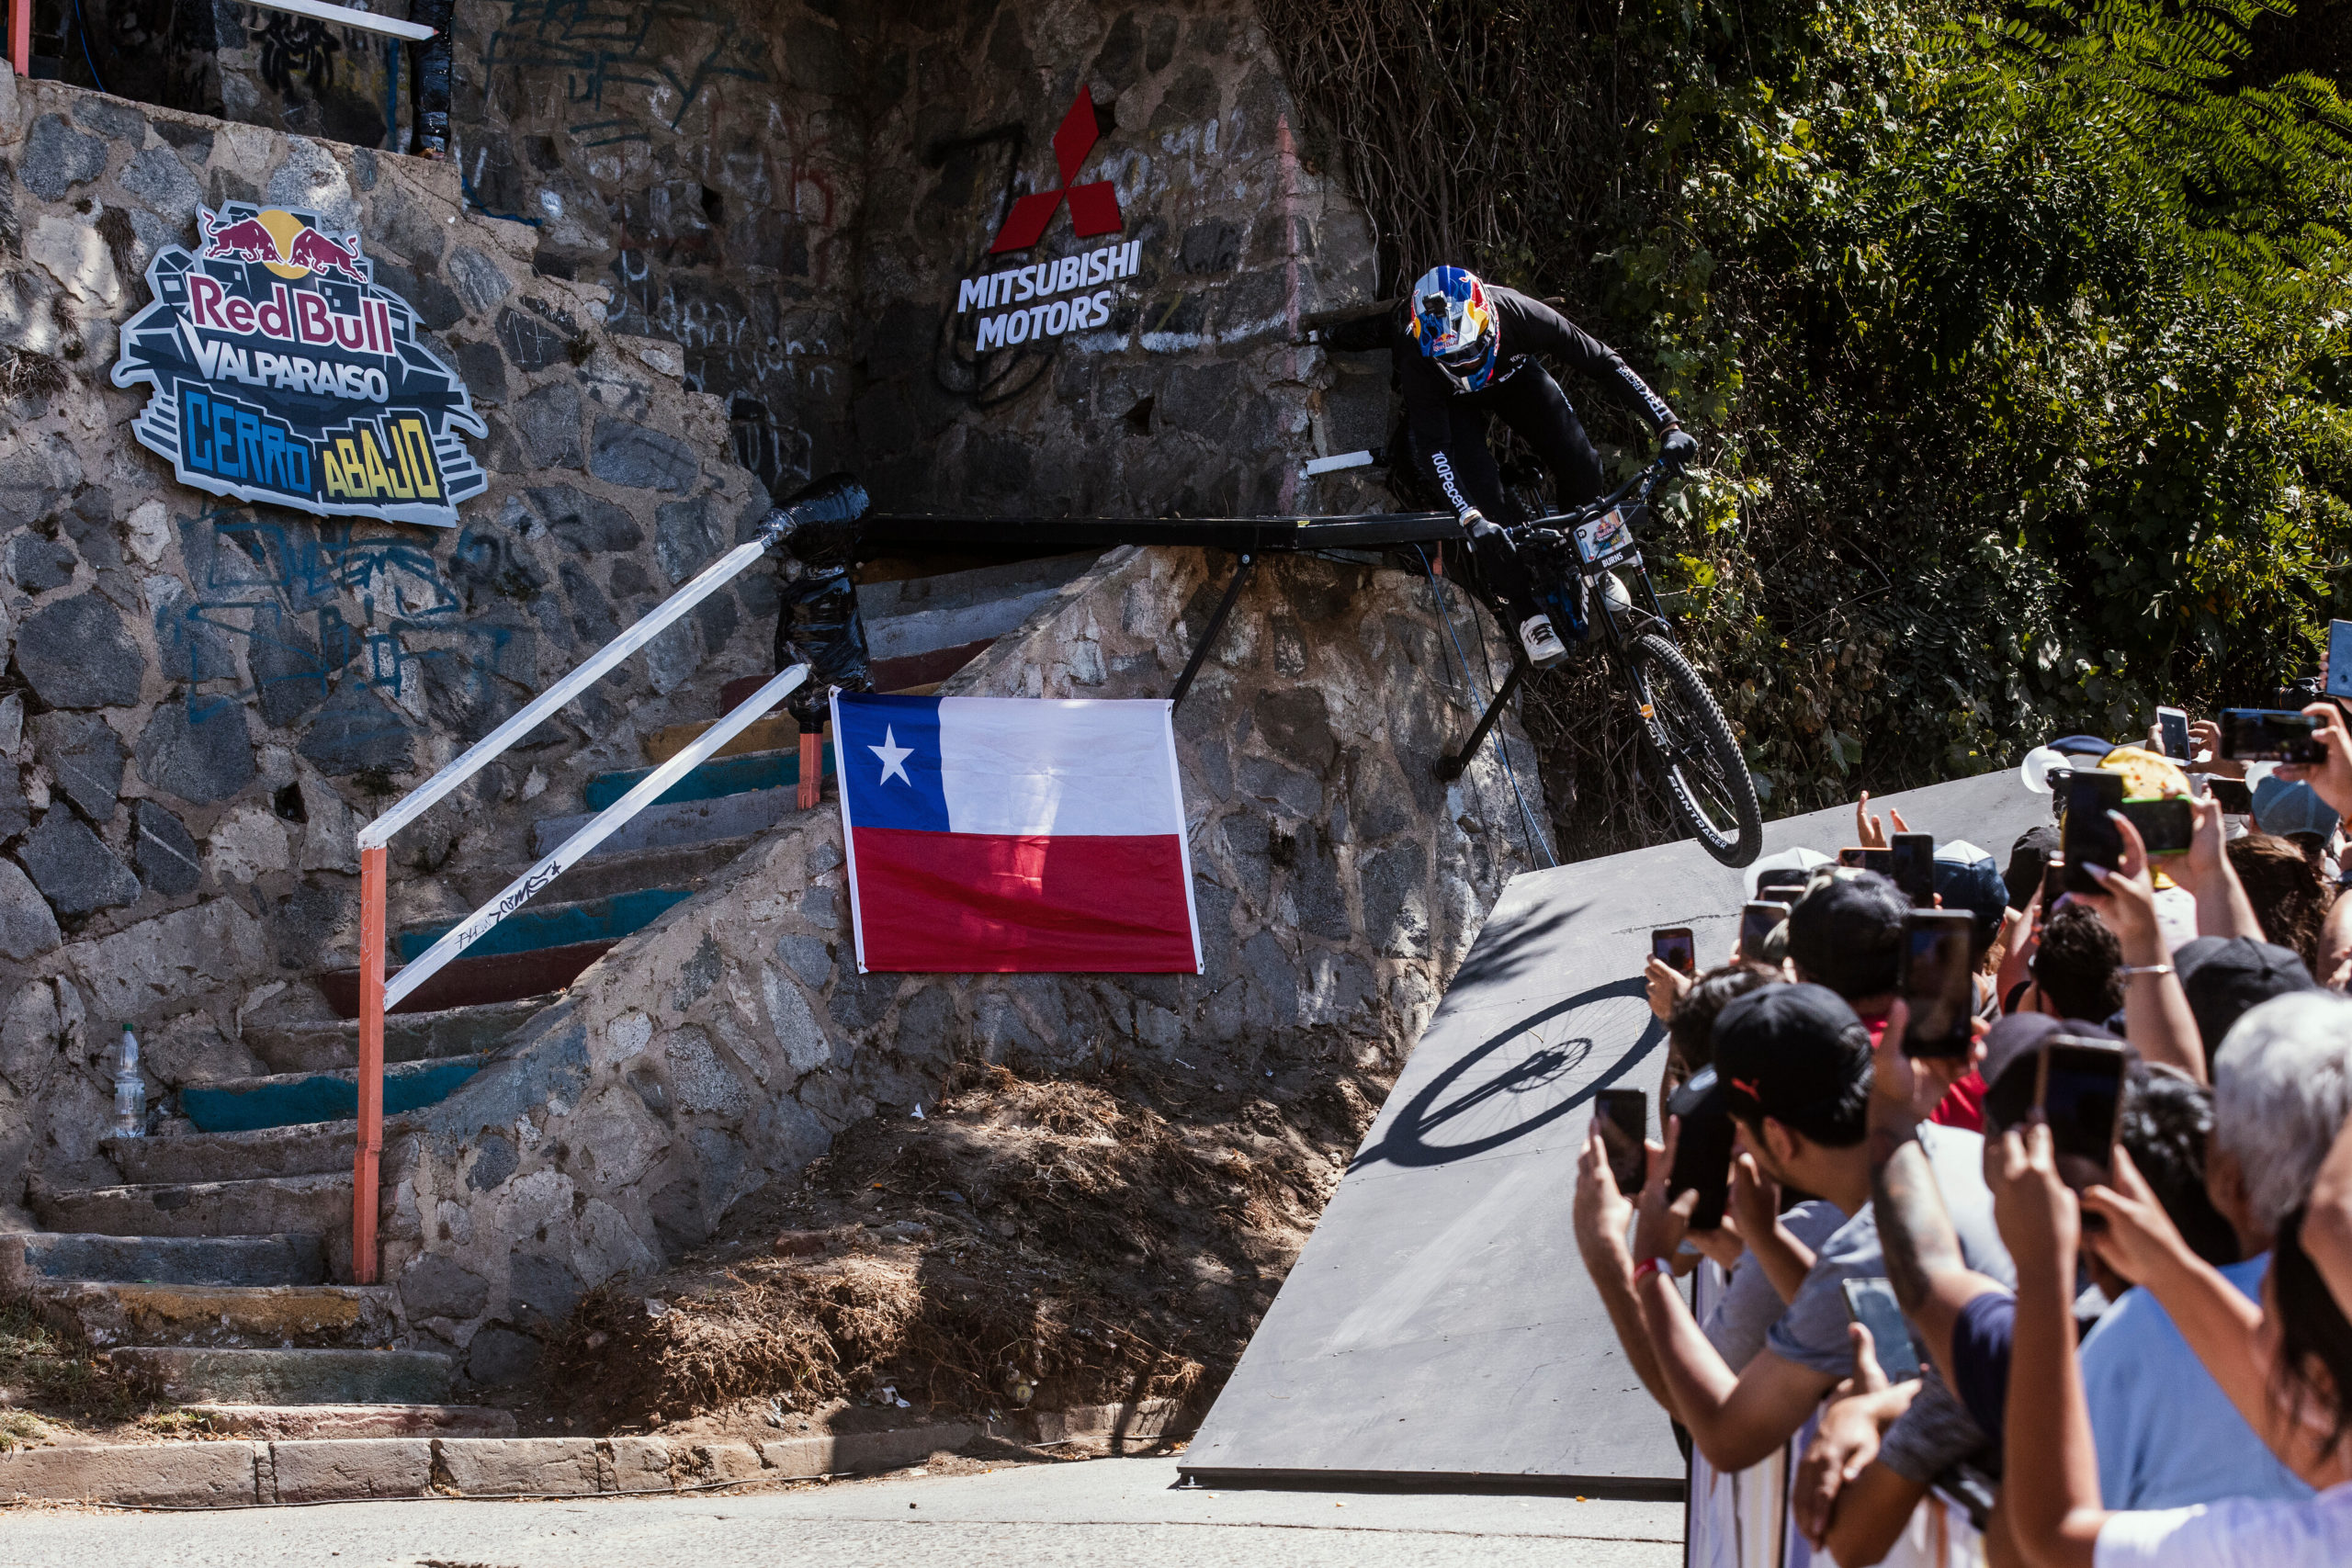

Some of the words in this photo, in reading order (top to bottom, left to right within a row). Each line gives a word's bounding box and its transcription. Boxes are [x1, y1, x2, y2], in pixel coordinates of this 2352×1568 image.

[188, 275, 294, 342] Red
[300, 288, 396, 355] Bull
[957, 240, 1141, 313] MITSUBISHI
[178, 310, 389, 403] VALPARAISO
[976, 290, 1112, 352] MOTORS
[185, 391, 311, 494] CERRO
[323, 418, 441, 500] ABAJO
[1601, 552, 1623, 569] BURNS
[1667, 774, 1727, 851] BONTRAGER
